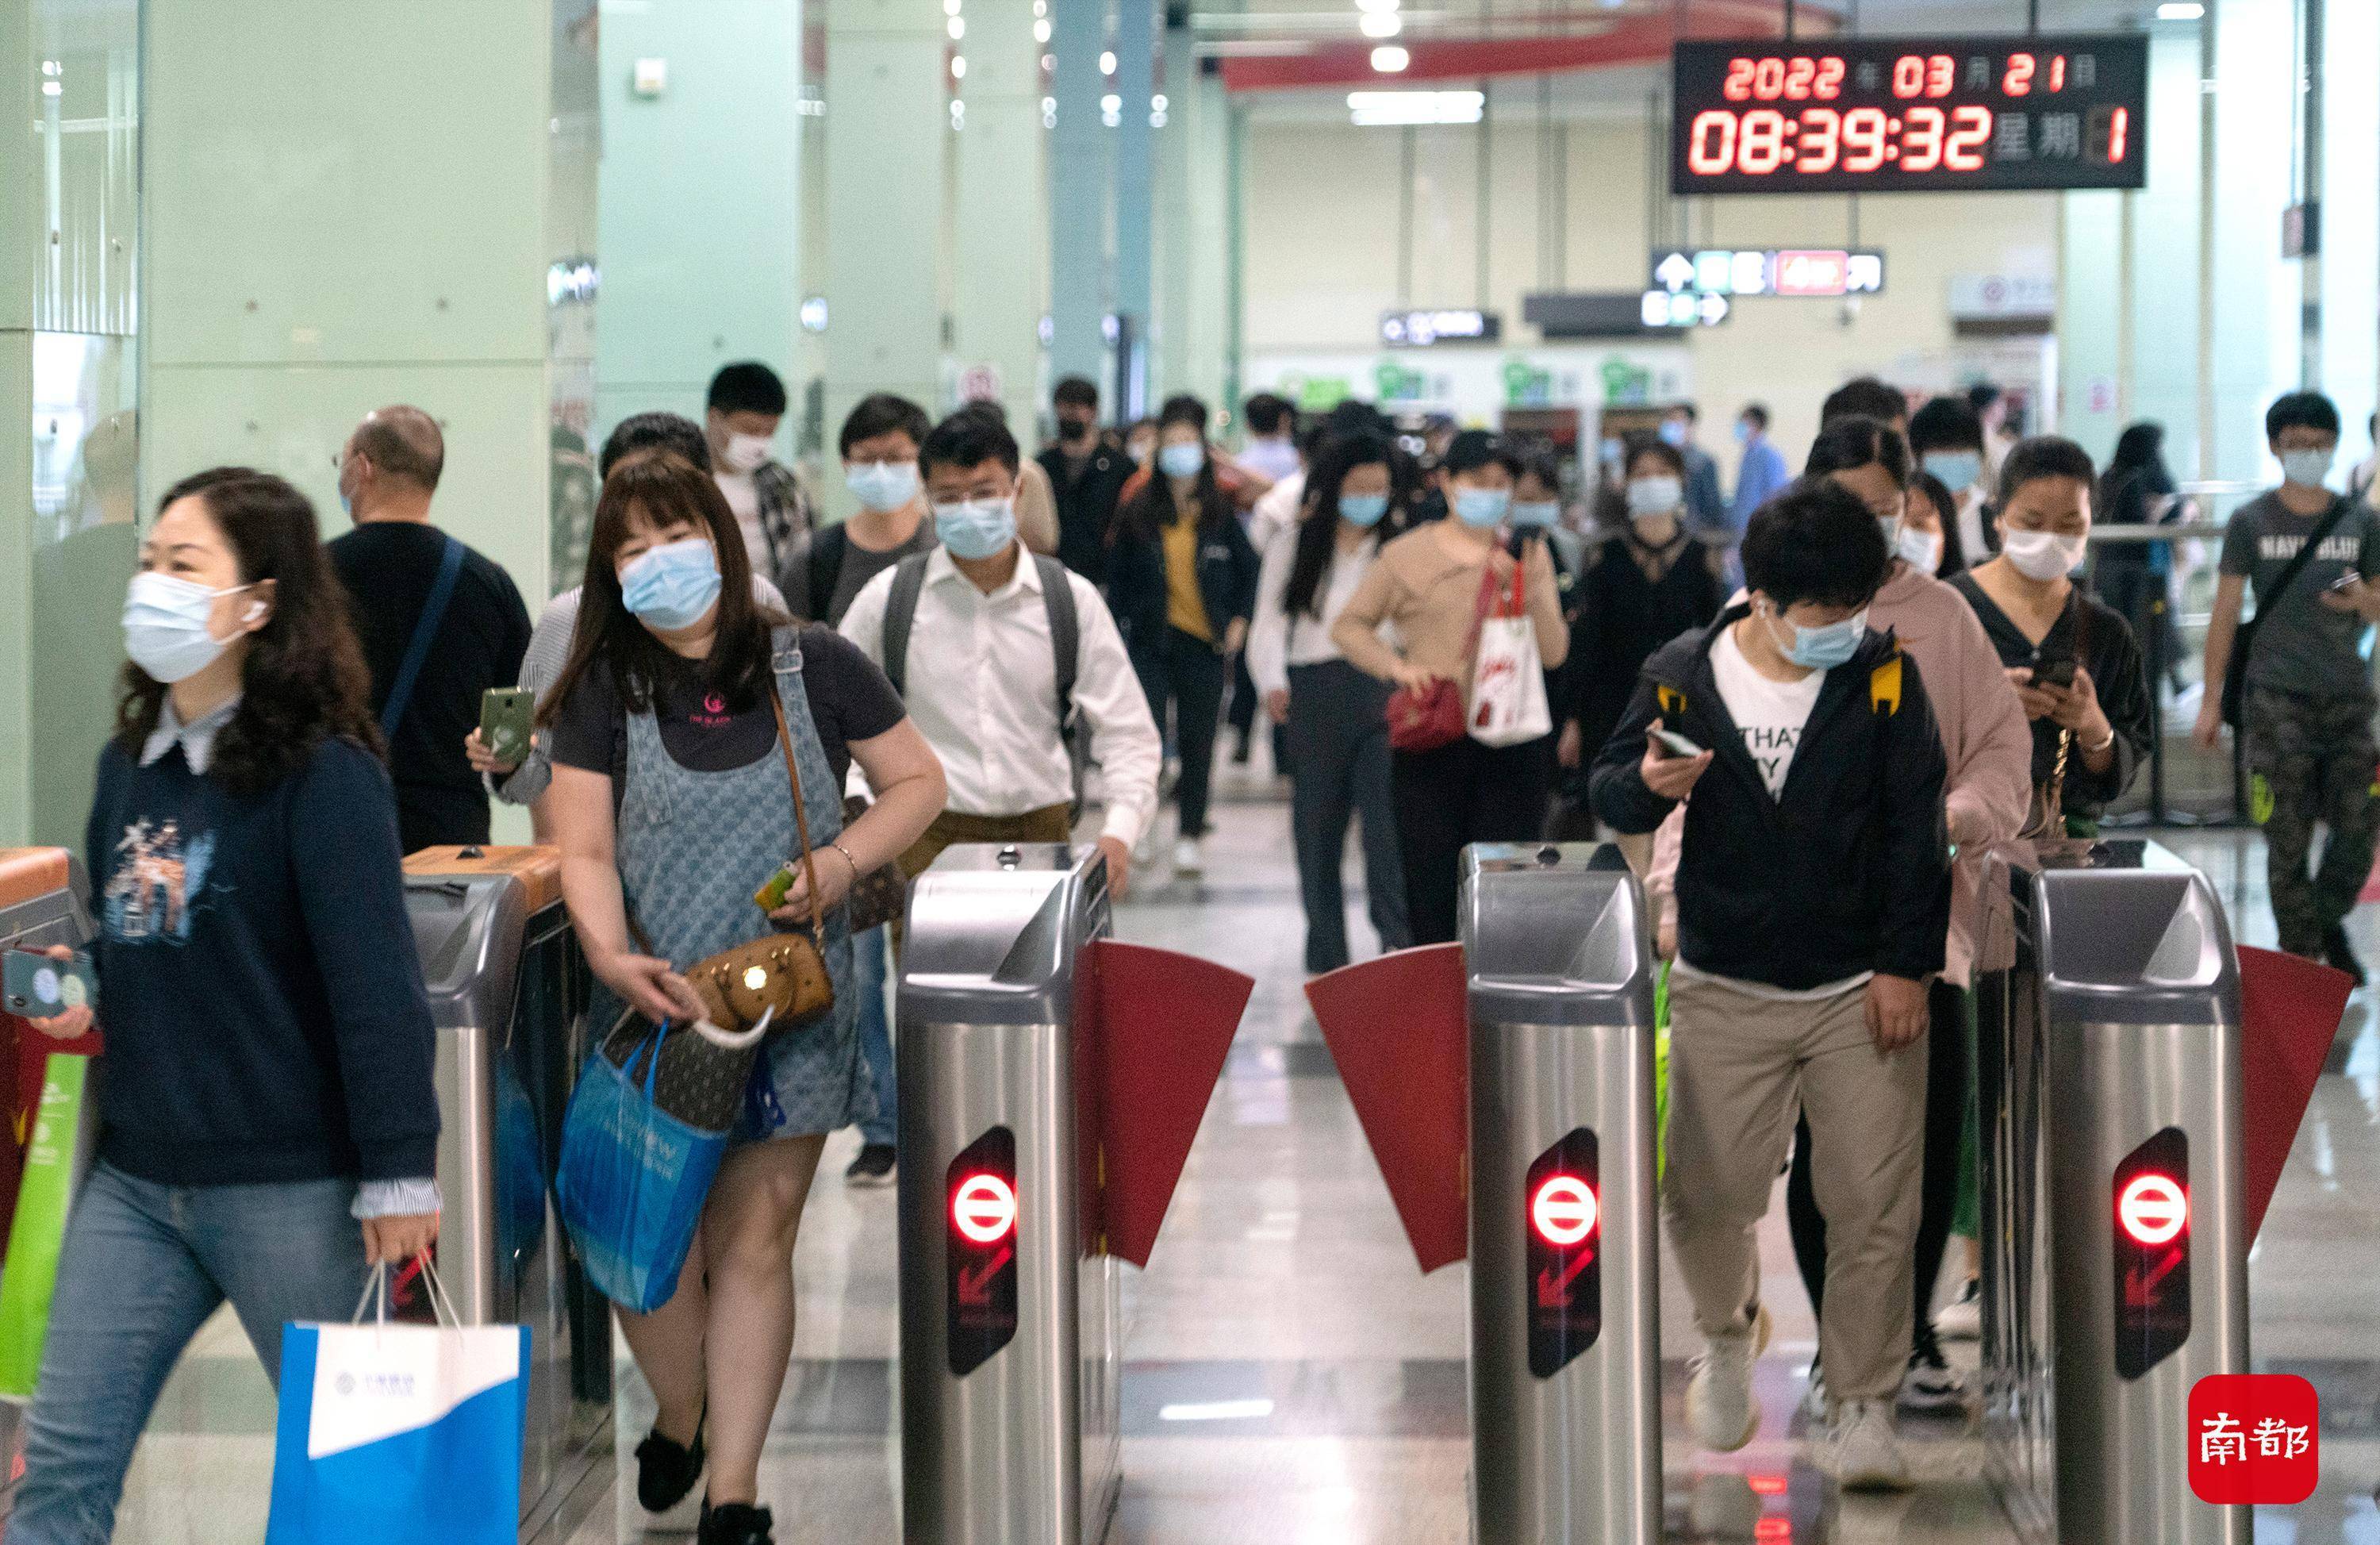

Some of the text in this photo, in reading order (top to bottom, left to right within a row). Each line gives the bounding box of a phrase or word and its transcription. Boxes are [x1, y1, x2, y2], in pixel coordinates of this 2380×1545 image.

[1723, 56, 1845, 102] 2022
[1892, 55, 1956, 99] 03
[2002, 52, 2067, 97] 21
[1688, 106, 1993, 176] 08:39:32
[2108, 106, 2129, 164] 1
